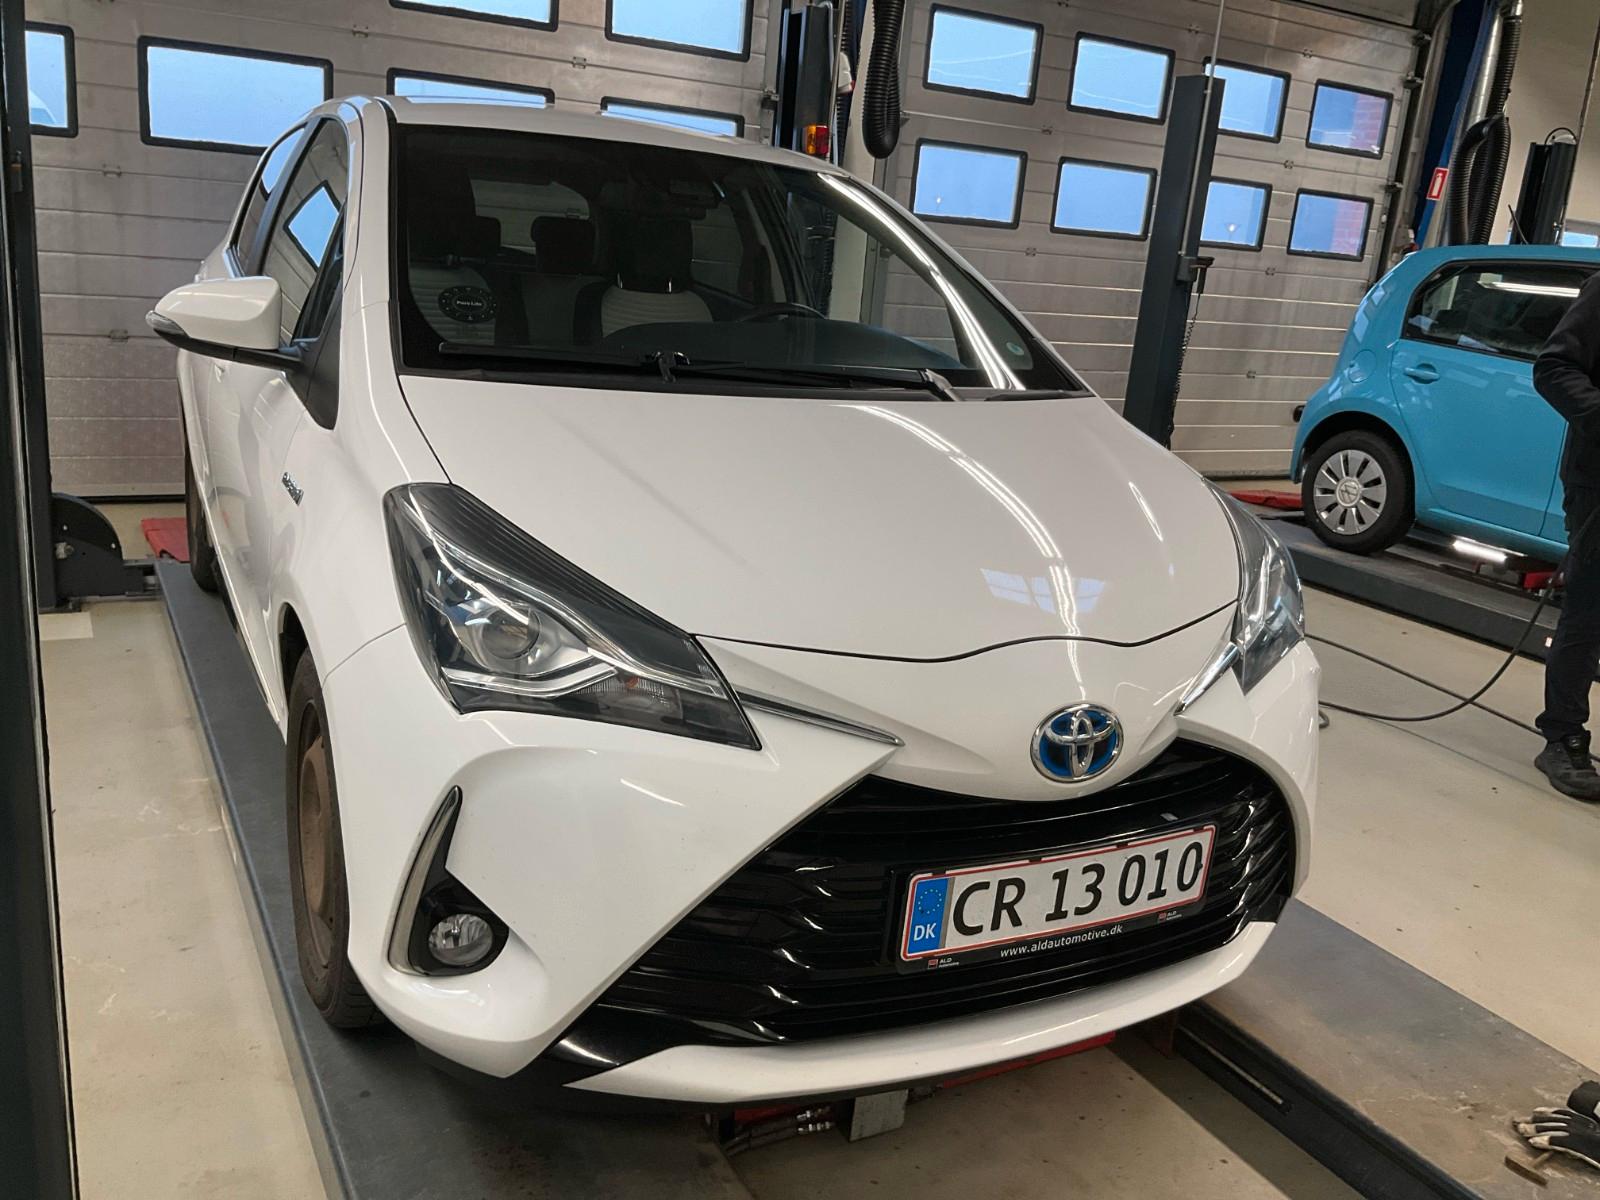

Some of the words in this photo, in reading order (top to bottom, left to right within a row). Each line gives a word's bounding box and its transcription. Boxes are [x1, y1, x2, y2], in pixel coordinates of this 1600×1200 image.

[952, 877, 1026, 936] CR
[1045, 863, 1106, 922] 13
[1118, 841, 1203, 907] 010
[913, 922, 937, 942] DK
[1000, 925, 1123, 958] www.aldautomotive.dk
